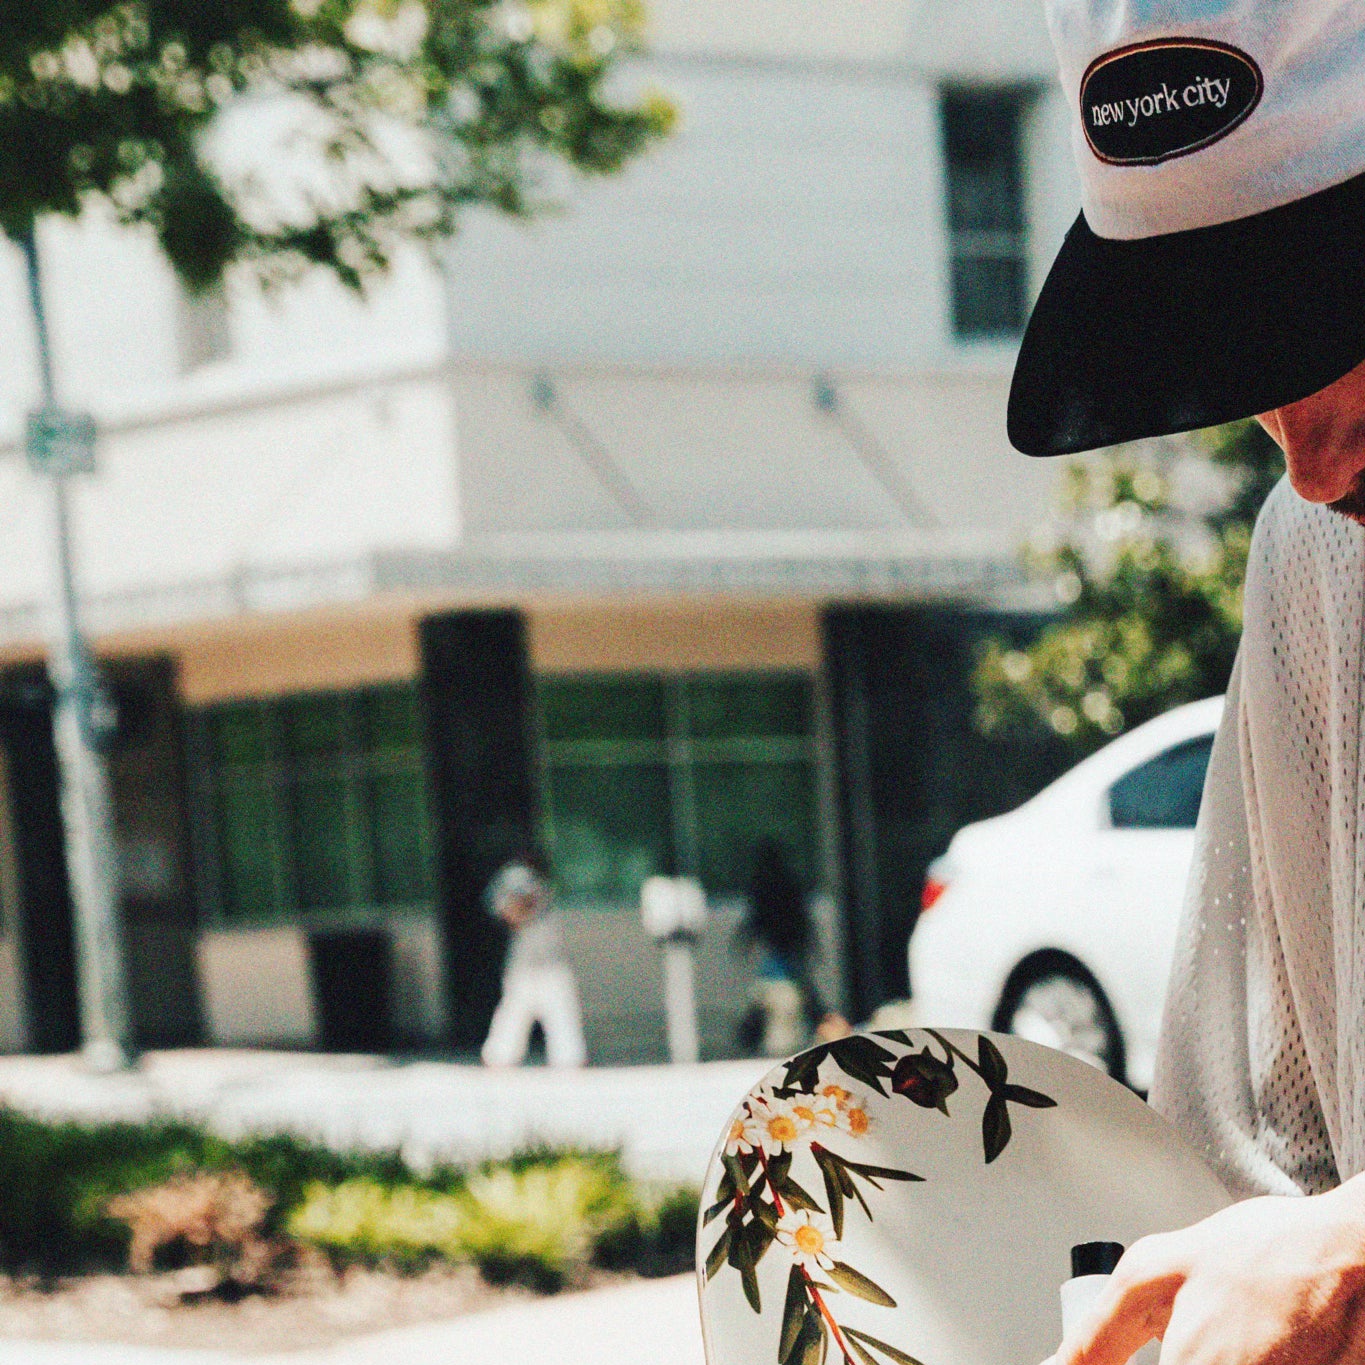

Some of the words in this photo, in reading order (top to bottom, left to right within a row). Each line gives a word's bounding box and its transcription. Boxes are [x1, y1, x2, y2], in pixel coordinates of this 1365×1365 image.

[1092, 101, 1124, 126] new
[1125, 82, 1181, 127] york
[1182, 75, 1231, 109] city
